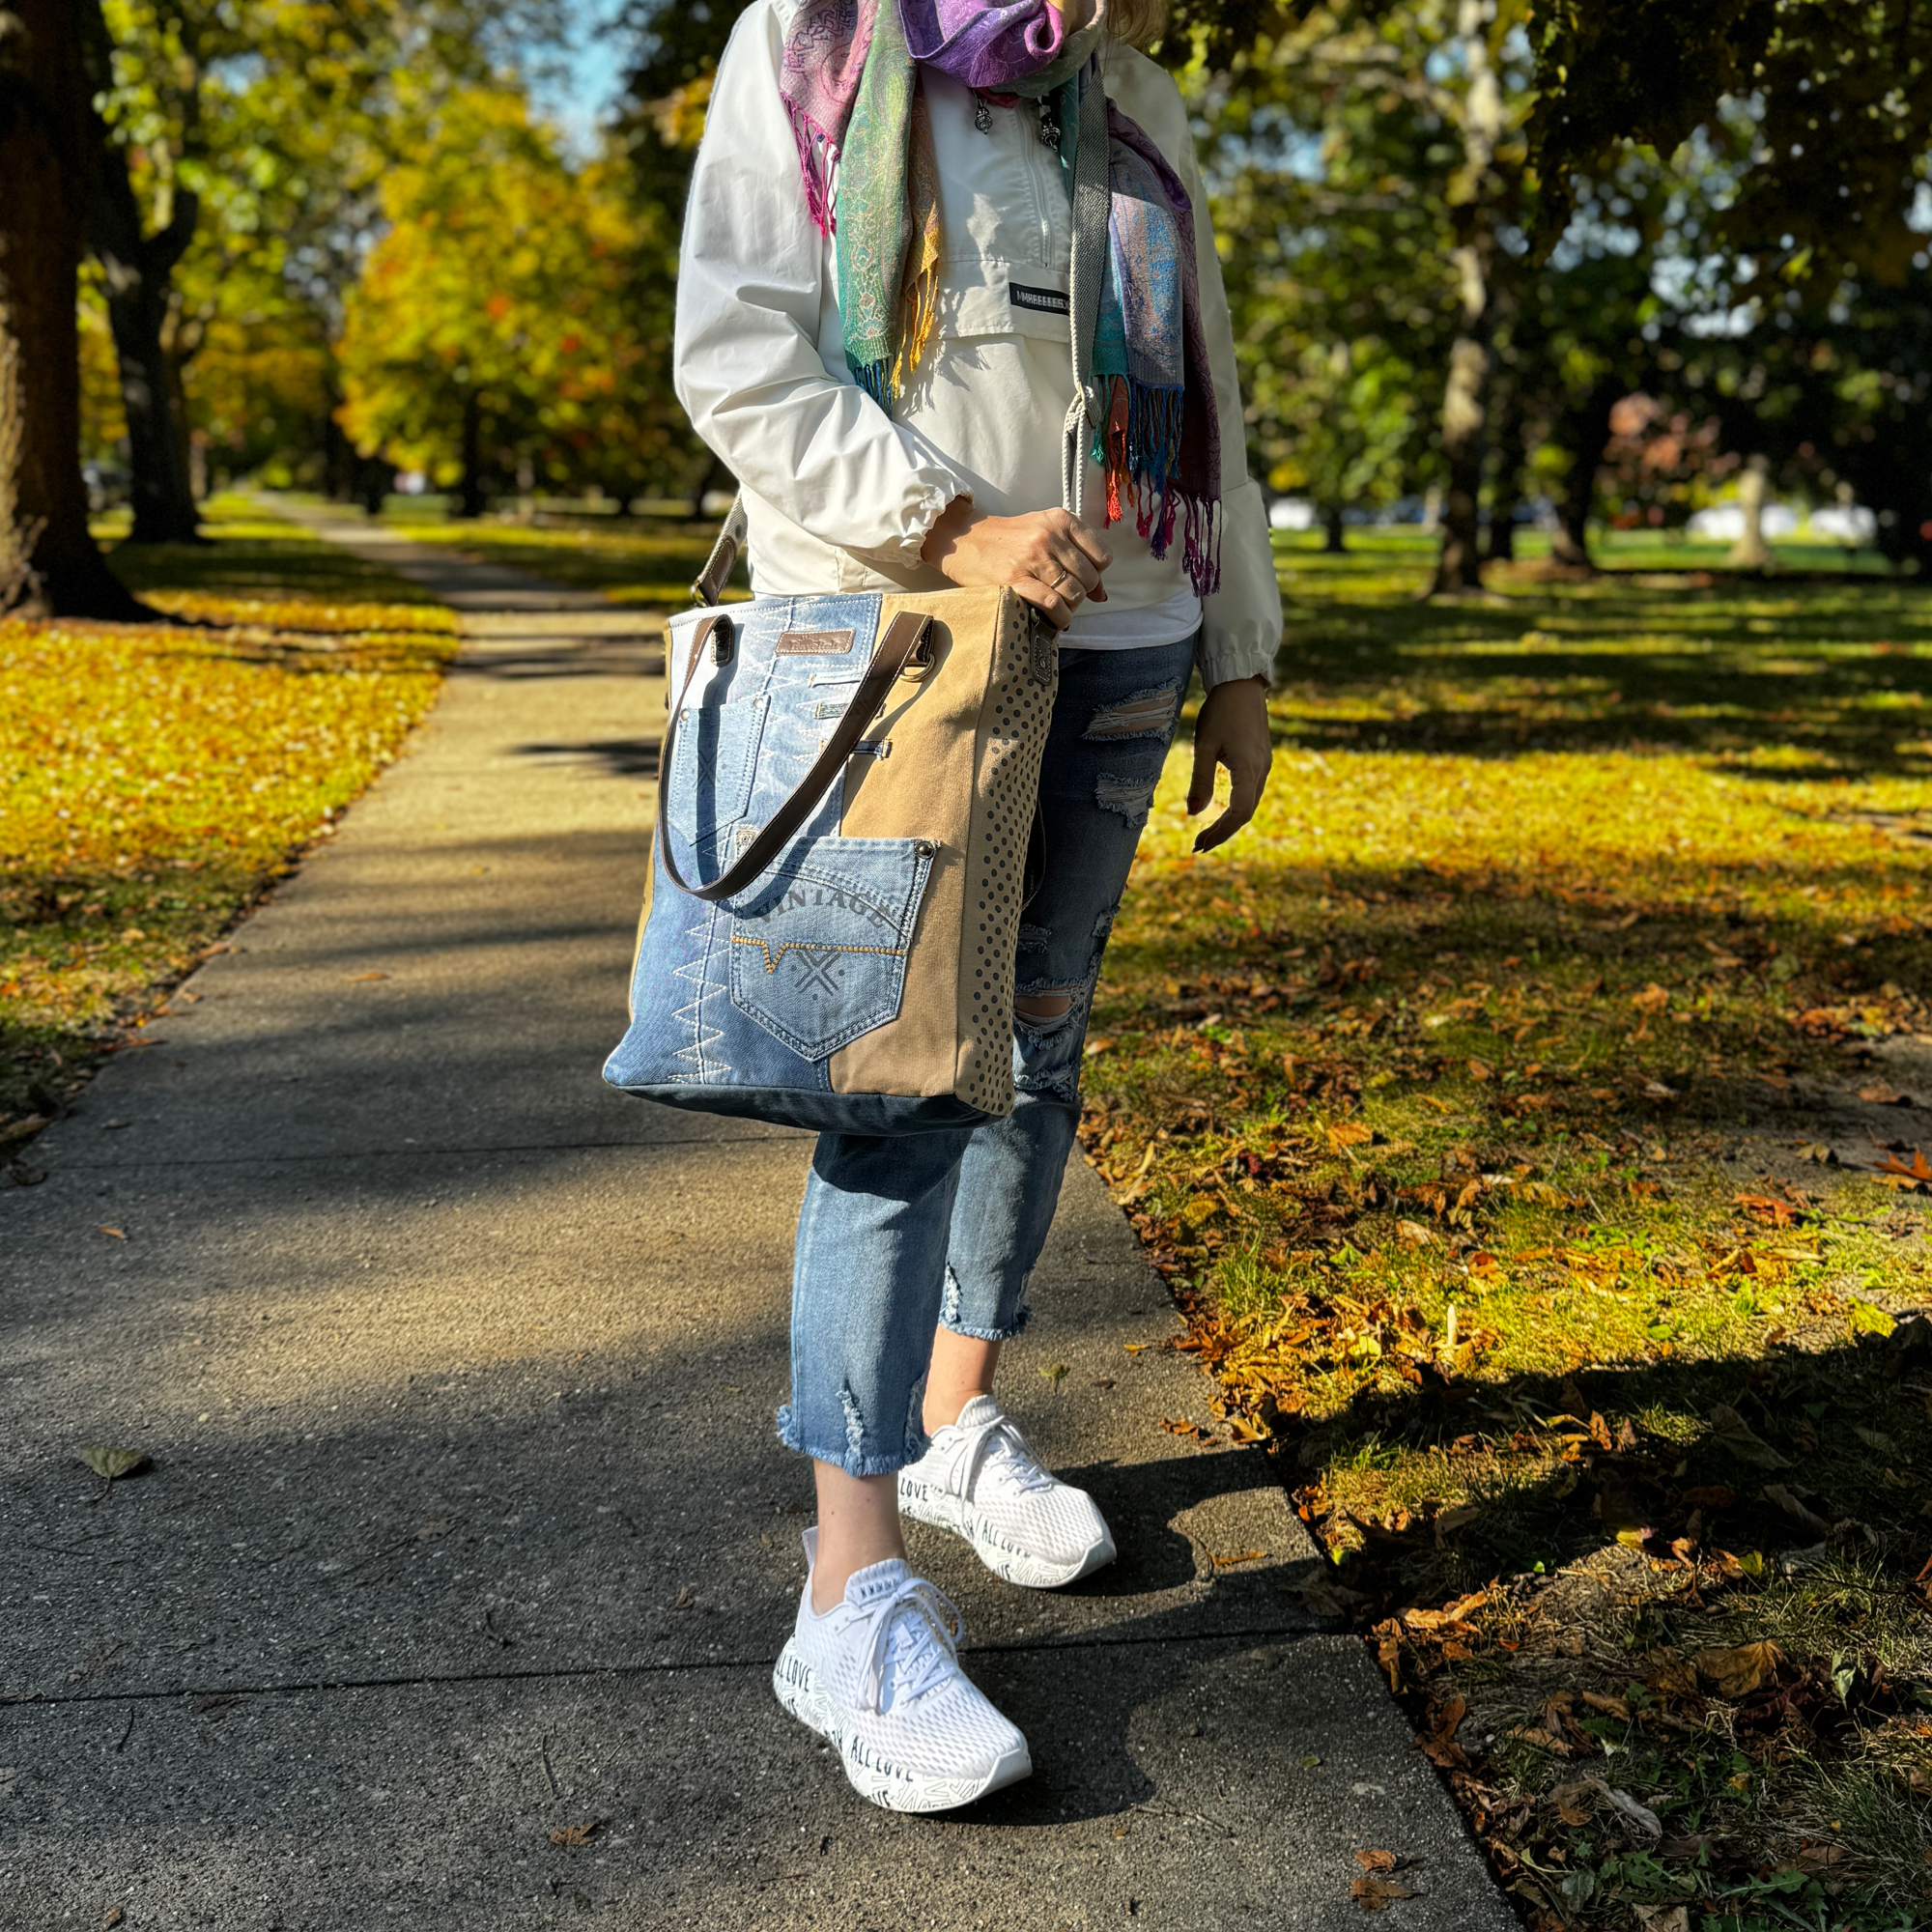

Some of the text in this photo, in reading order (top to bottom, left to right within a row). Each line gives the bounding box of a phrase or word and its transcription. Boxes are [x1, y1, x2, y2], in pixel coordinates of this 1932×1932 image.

[753, 889, 892, 928] VINTAGE
[900, 1477, 928, 1502] LOVE
[981, 1520, 999, 1547] ALL
[786, 1656, 810, 1692] LOVE
[851, 1735, 870, 1768] ALL
